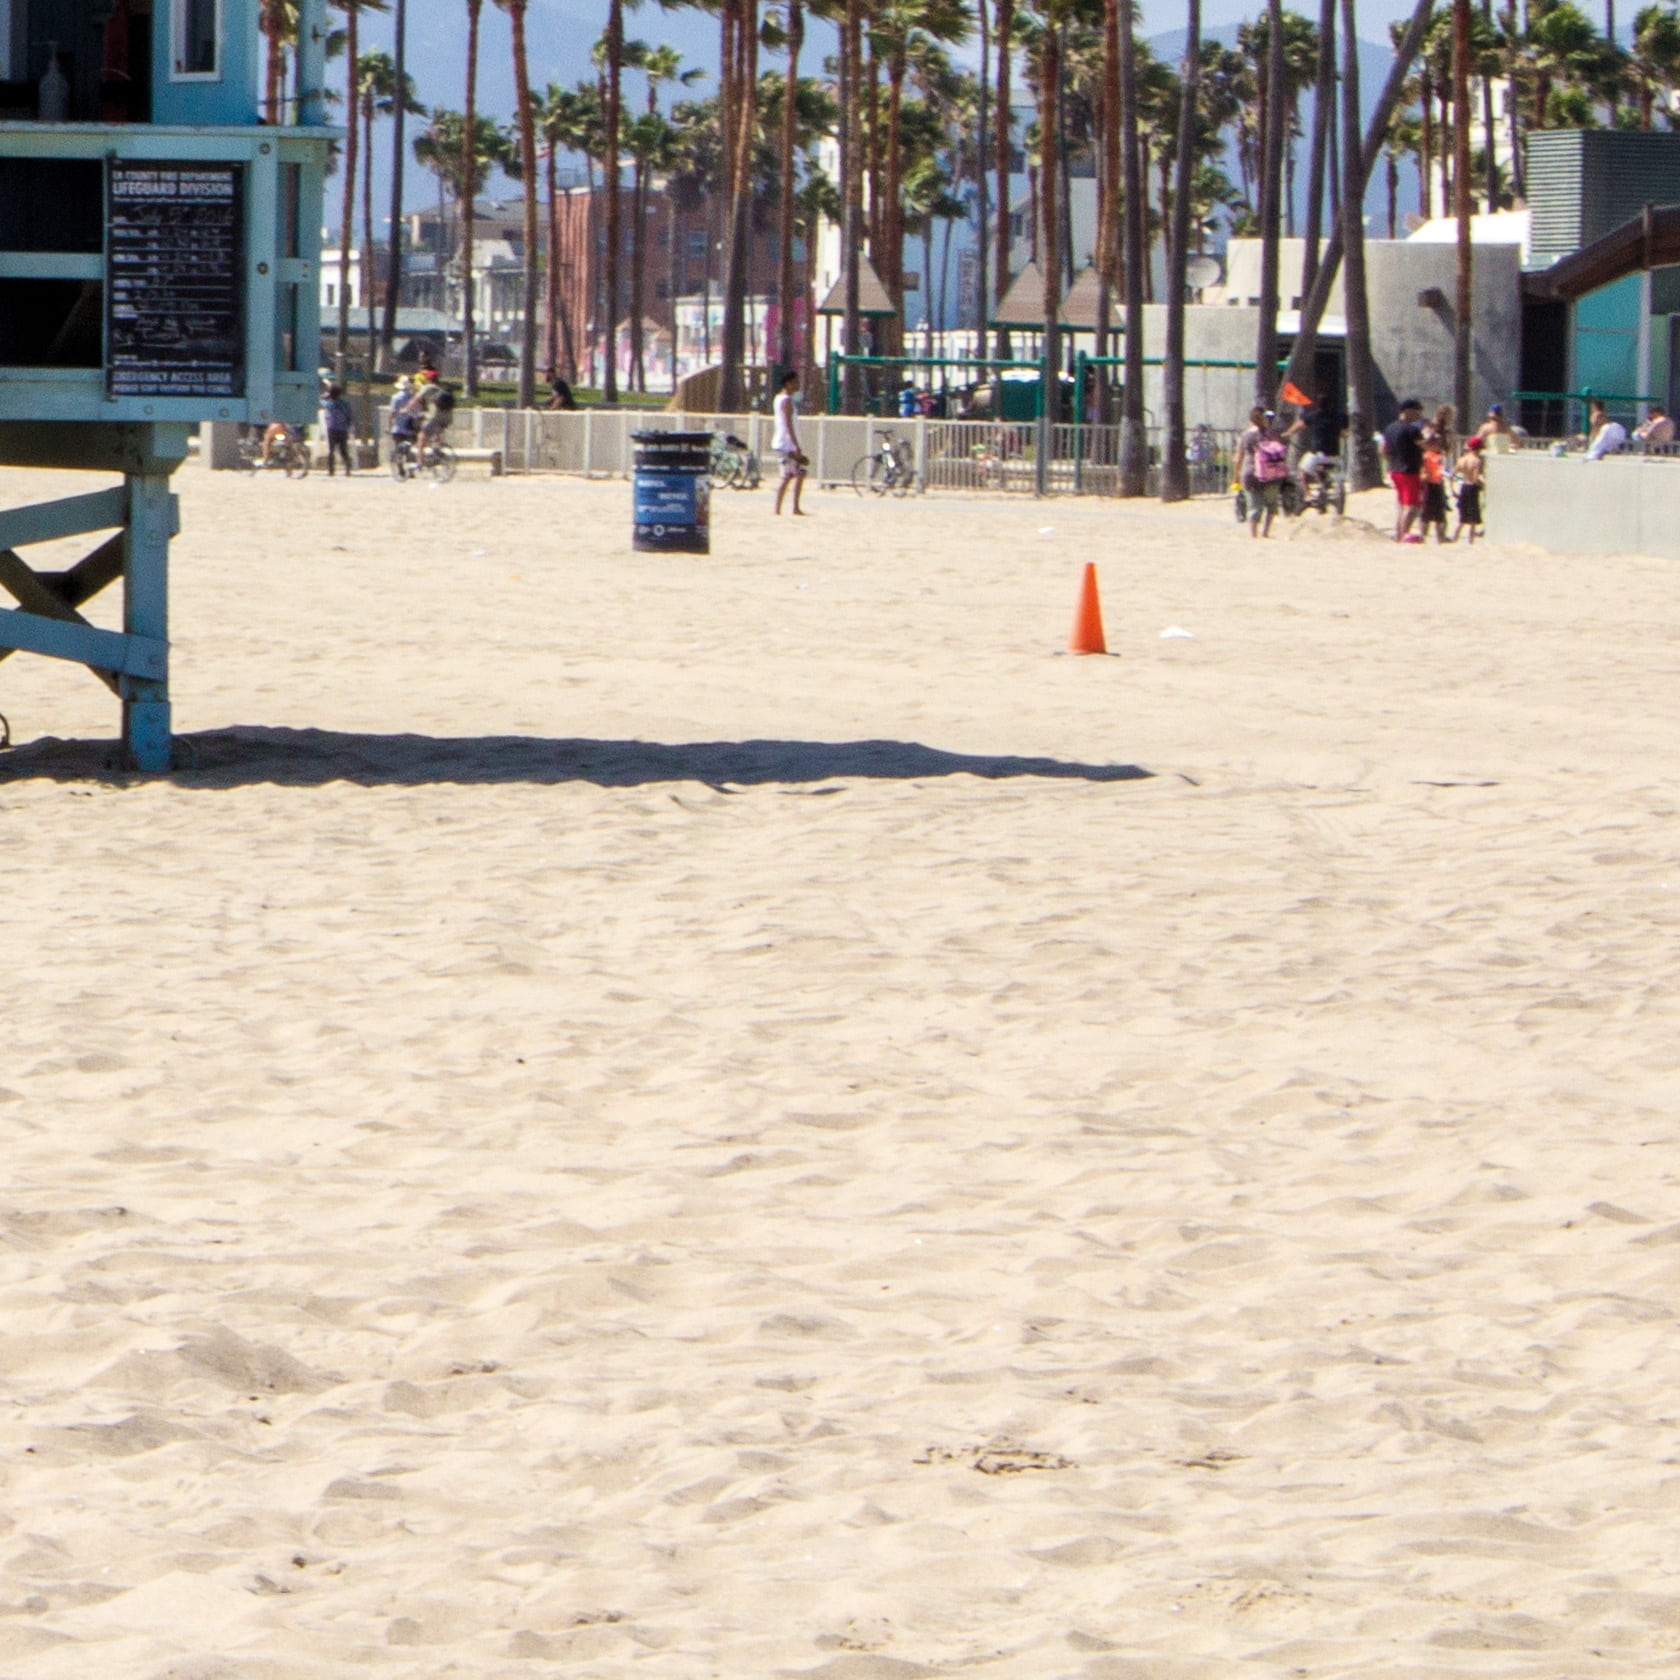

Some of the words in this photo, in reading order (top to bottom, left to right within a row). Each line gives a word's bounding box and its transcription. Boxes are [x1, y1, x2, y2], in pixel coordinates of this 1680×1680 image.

[112, 182, 177, 195] LIFEGUARD
[180, 182, 233, 195] DIVISION
[113, 371, 168, 383] EMERGENCY
[170, 371, 204, 383] ACCESS
